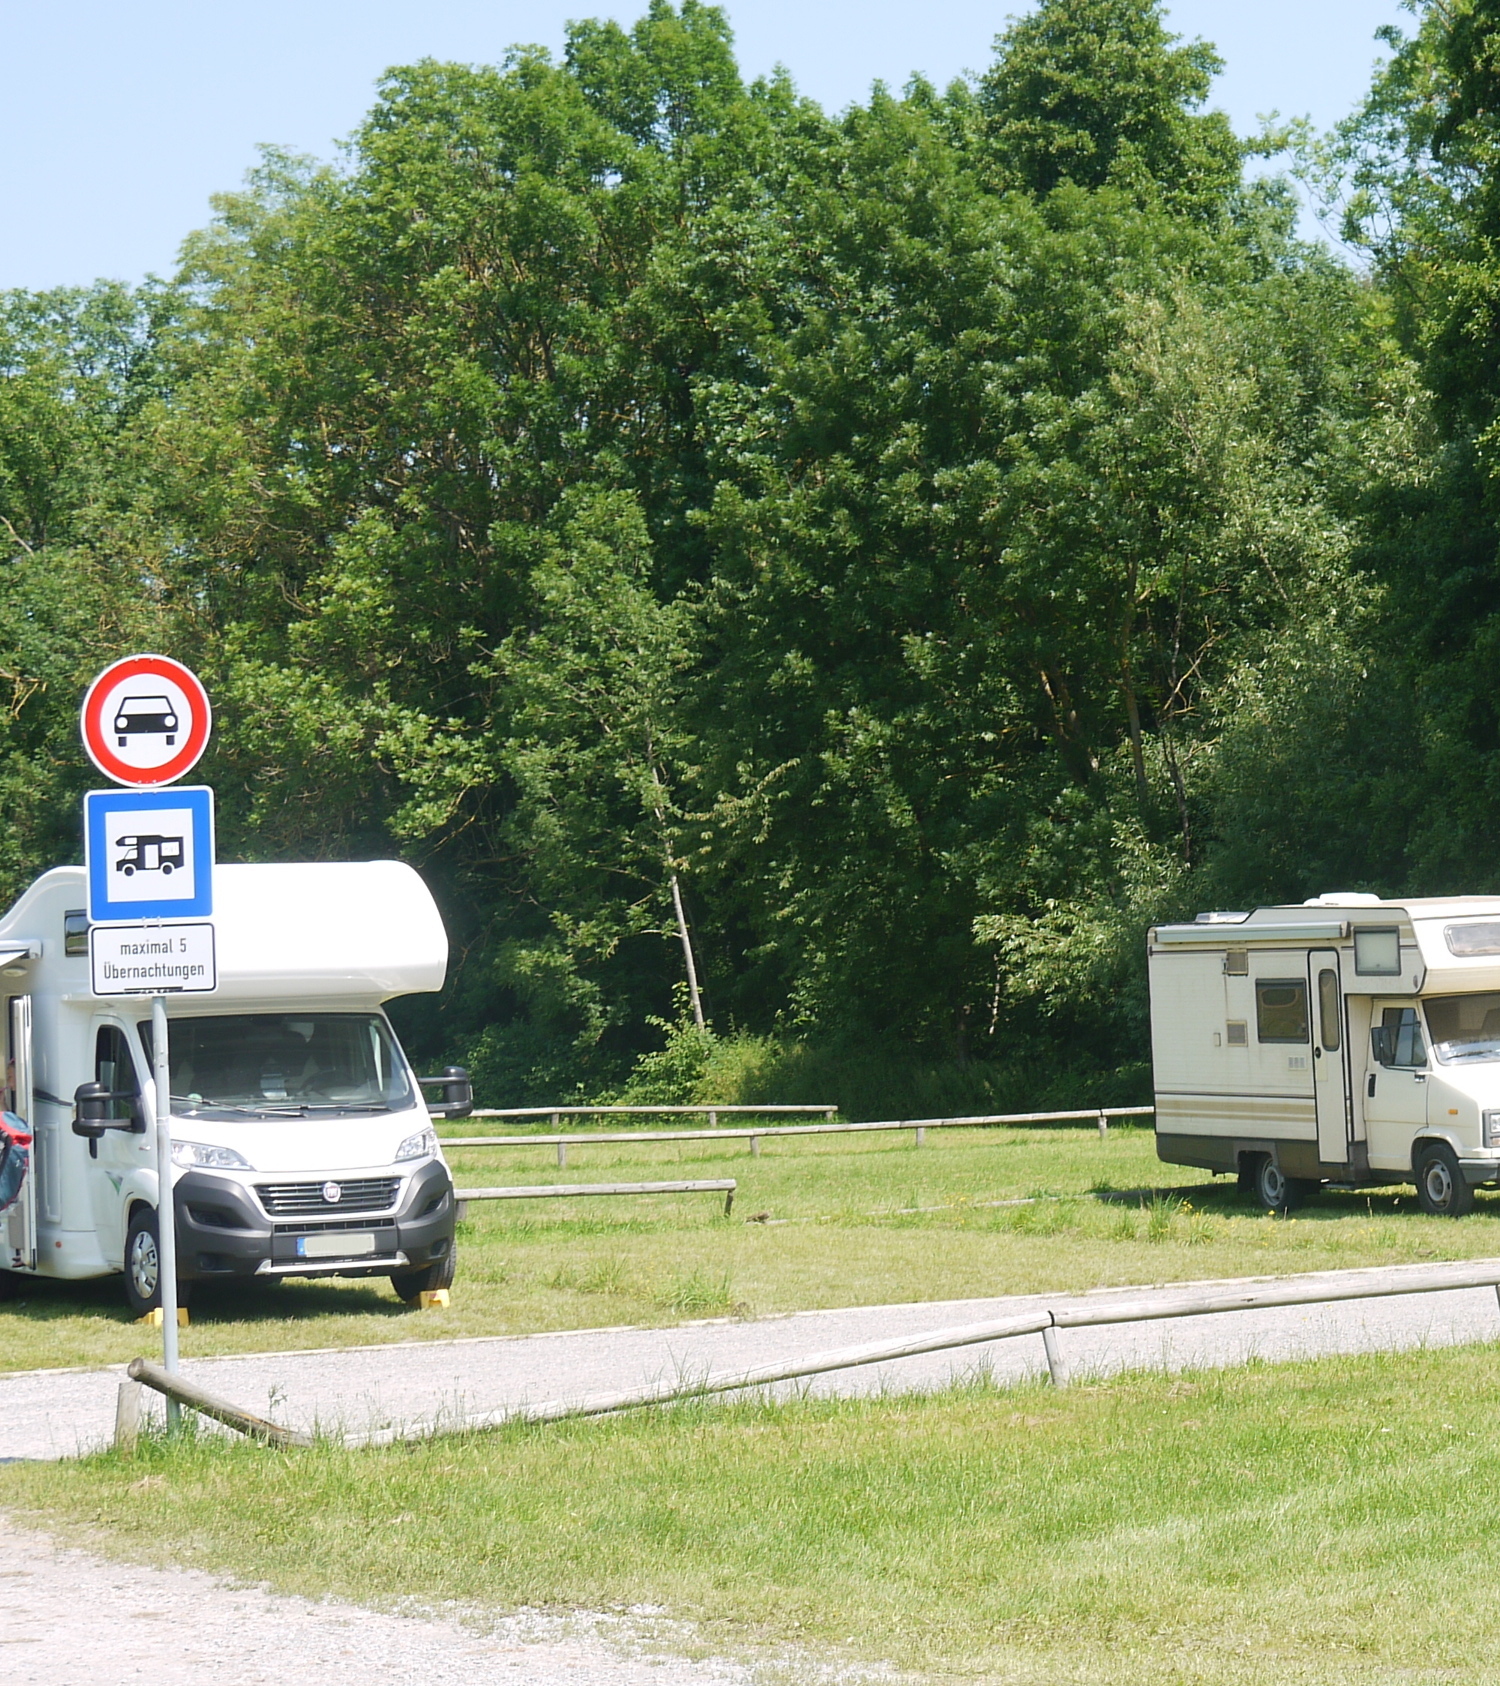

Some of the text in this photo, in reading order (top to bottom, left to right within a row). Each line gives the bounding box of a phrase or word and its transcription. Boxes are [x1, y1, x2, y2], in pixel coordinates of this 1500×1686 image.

[120, 937, 187, 955] maximal 5
[103, 961, 205, 980] Übernachtungen
